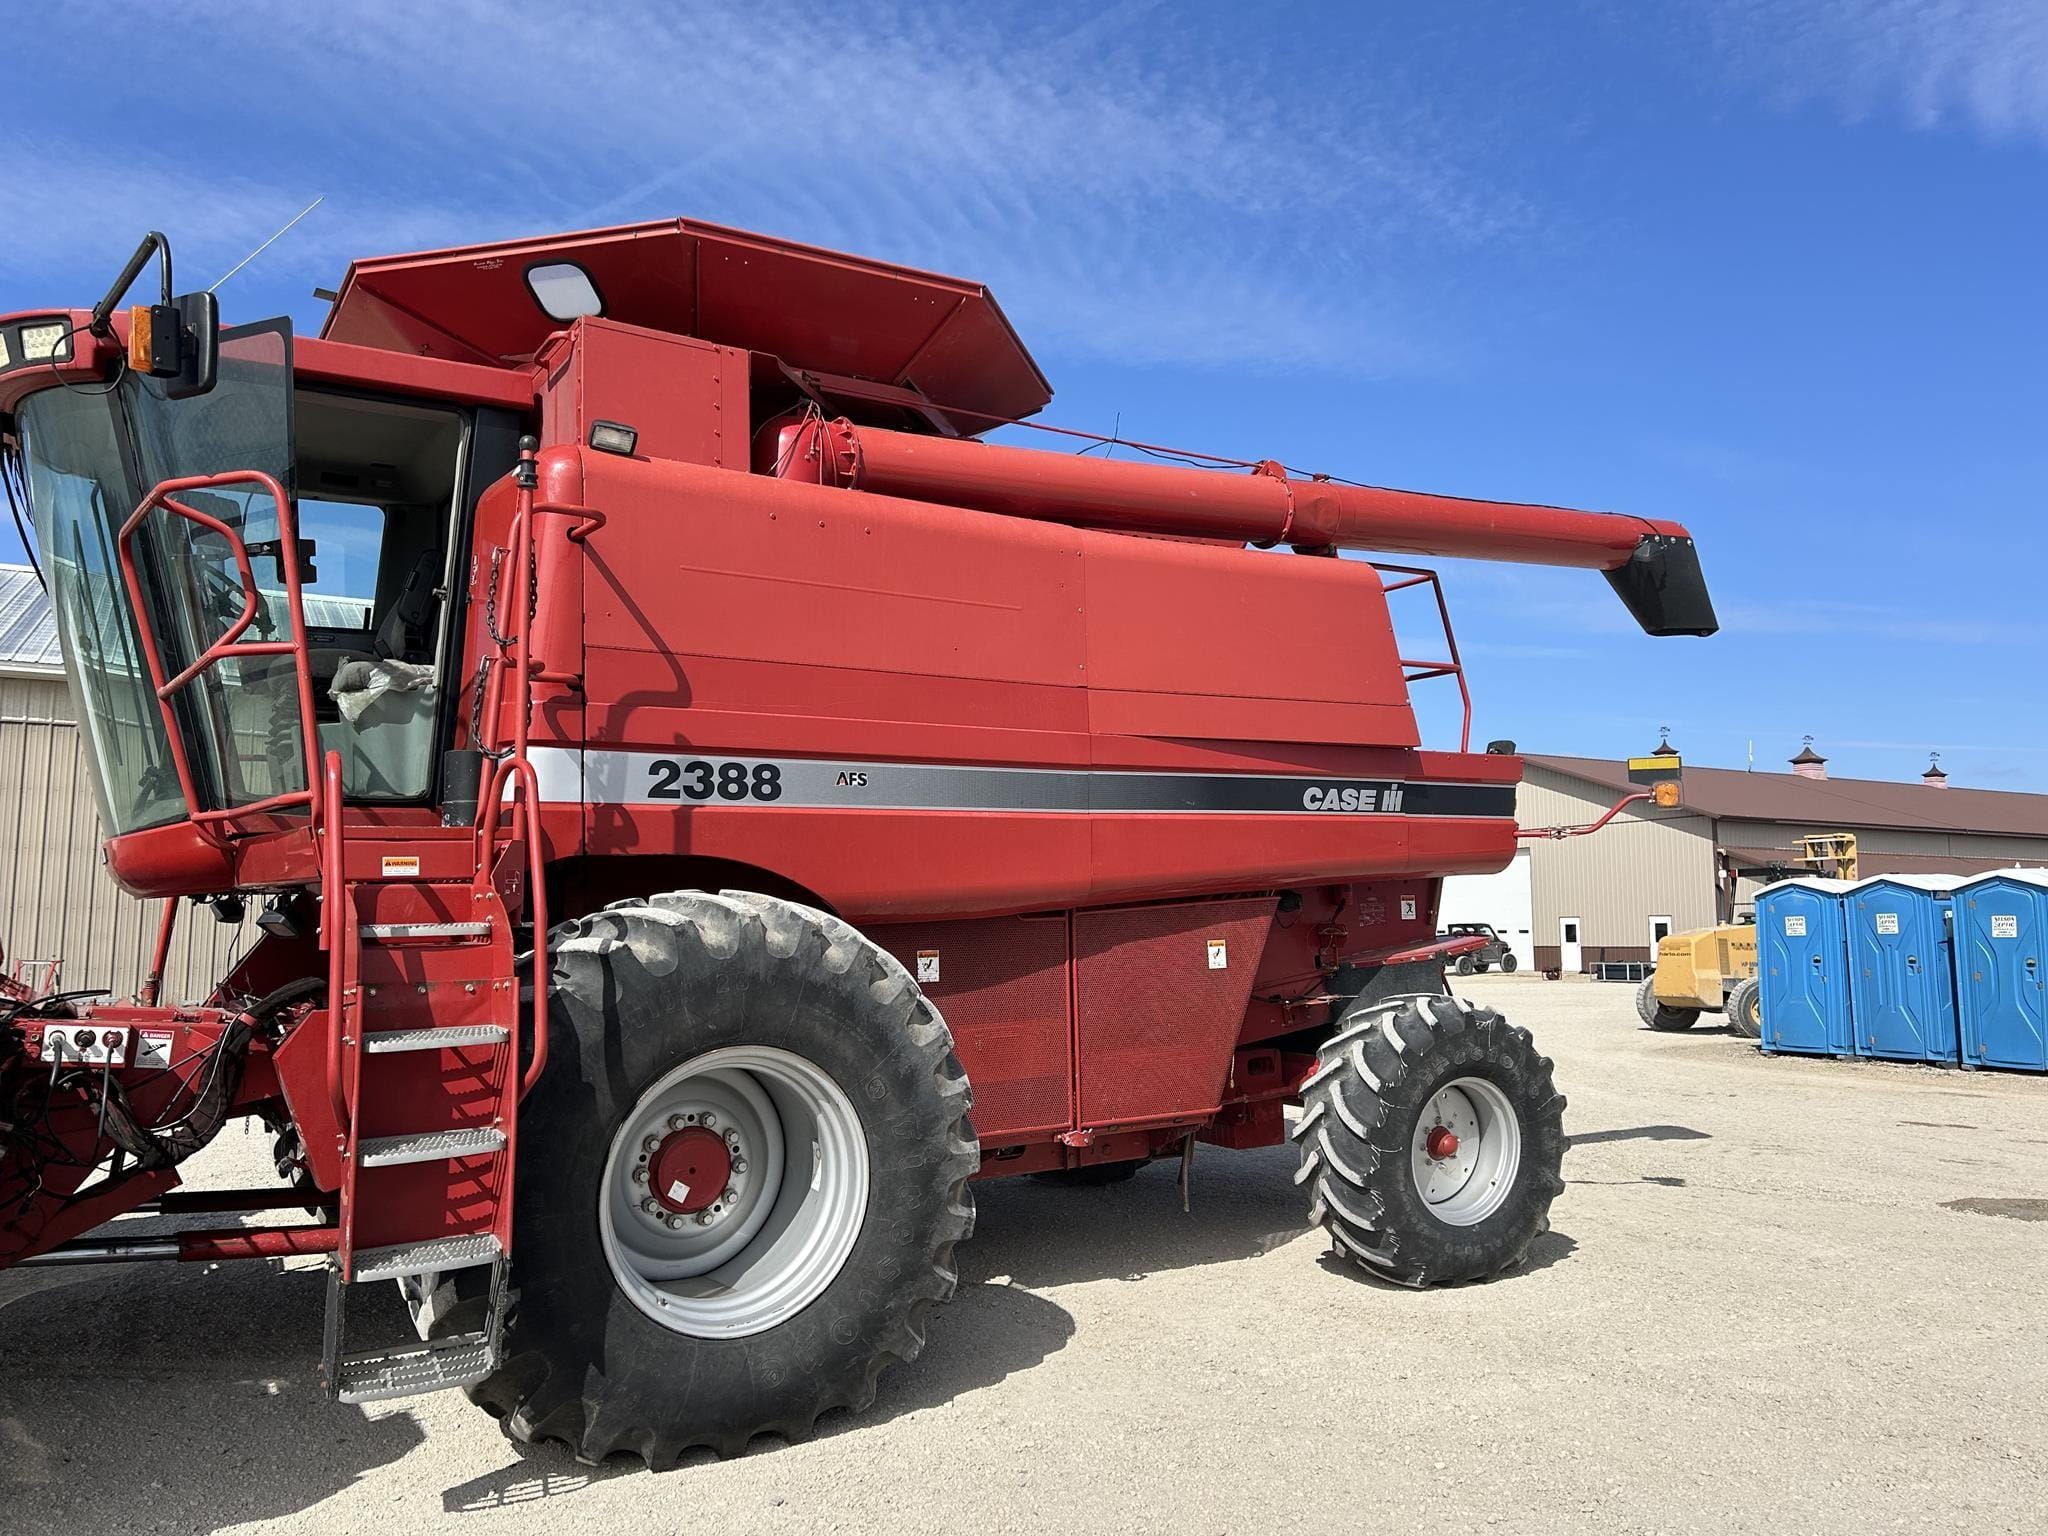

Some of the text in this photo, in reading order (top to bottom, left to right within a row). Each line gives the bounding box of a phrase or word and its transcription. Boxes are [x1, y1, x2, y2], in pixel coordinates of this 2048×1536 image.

[647, 759, 783, 802] 2388
[835, 771, 868, 787] AFS
[1302, 786, 1377, 811] CASE
